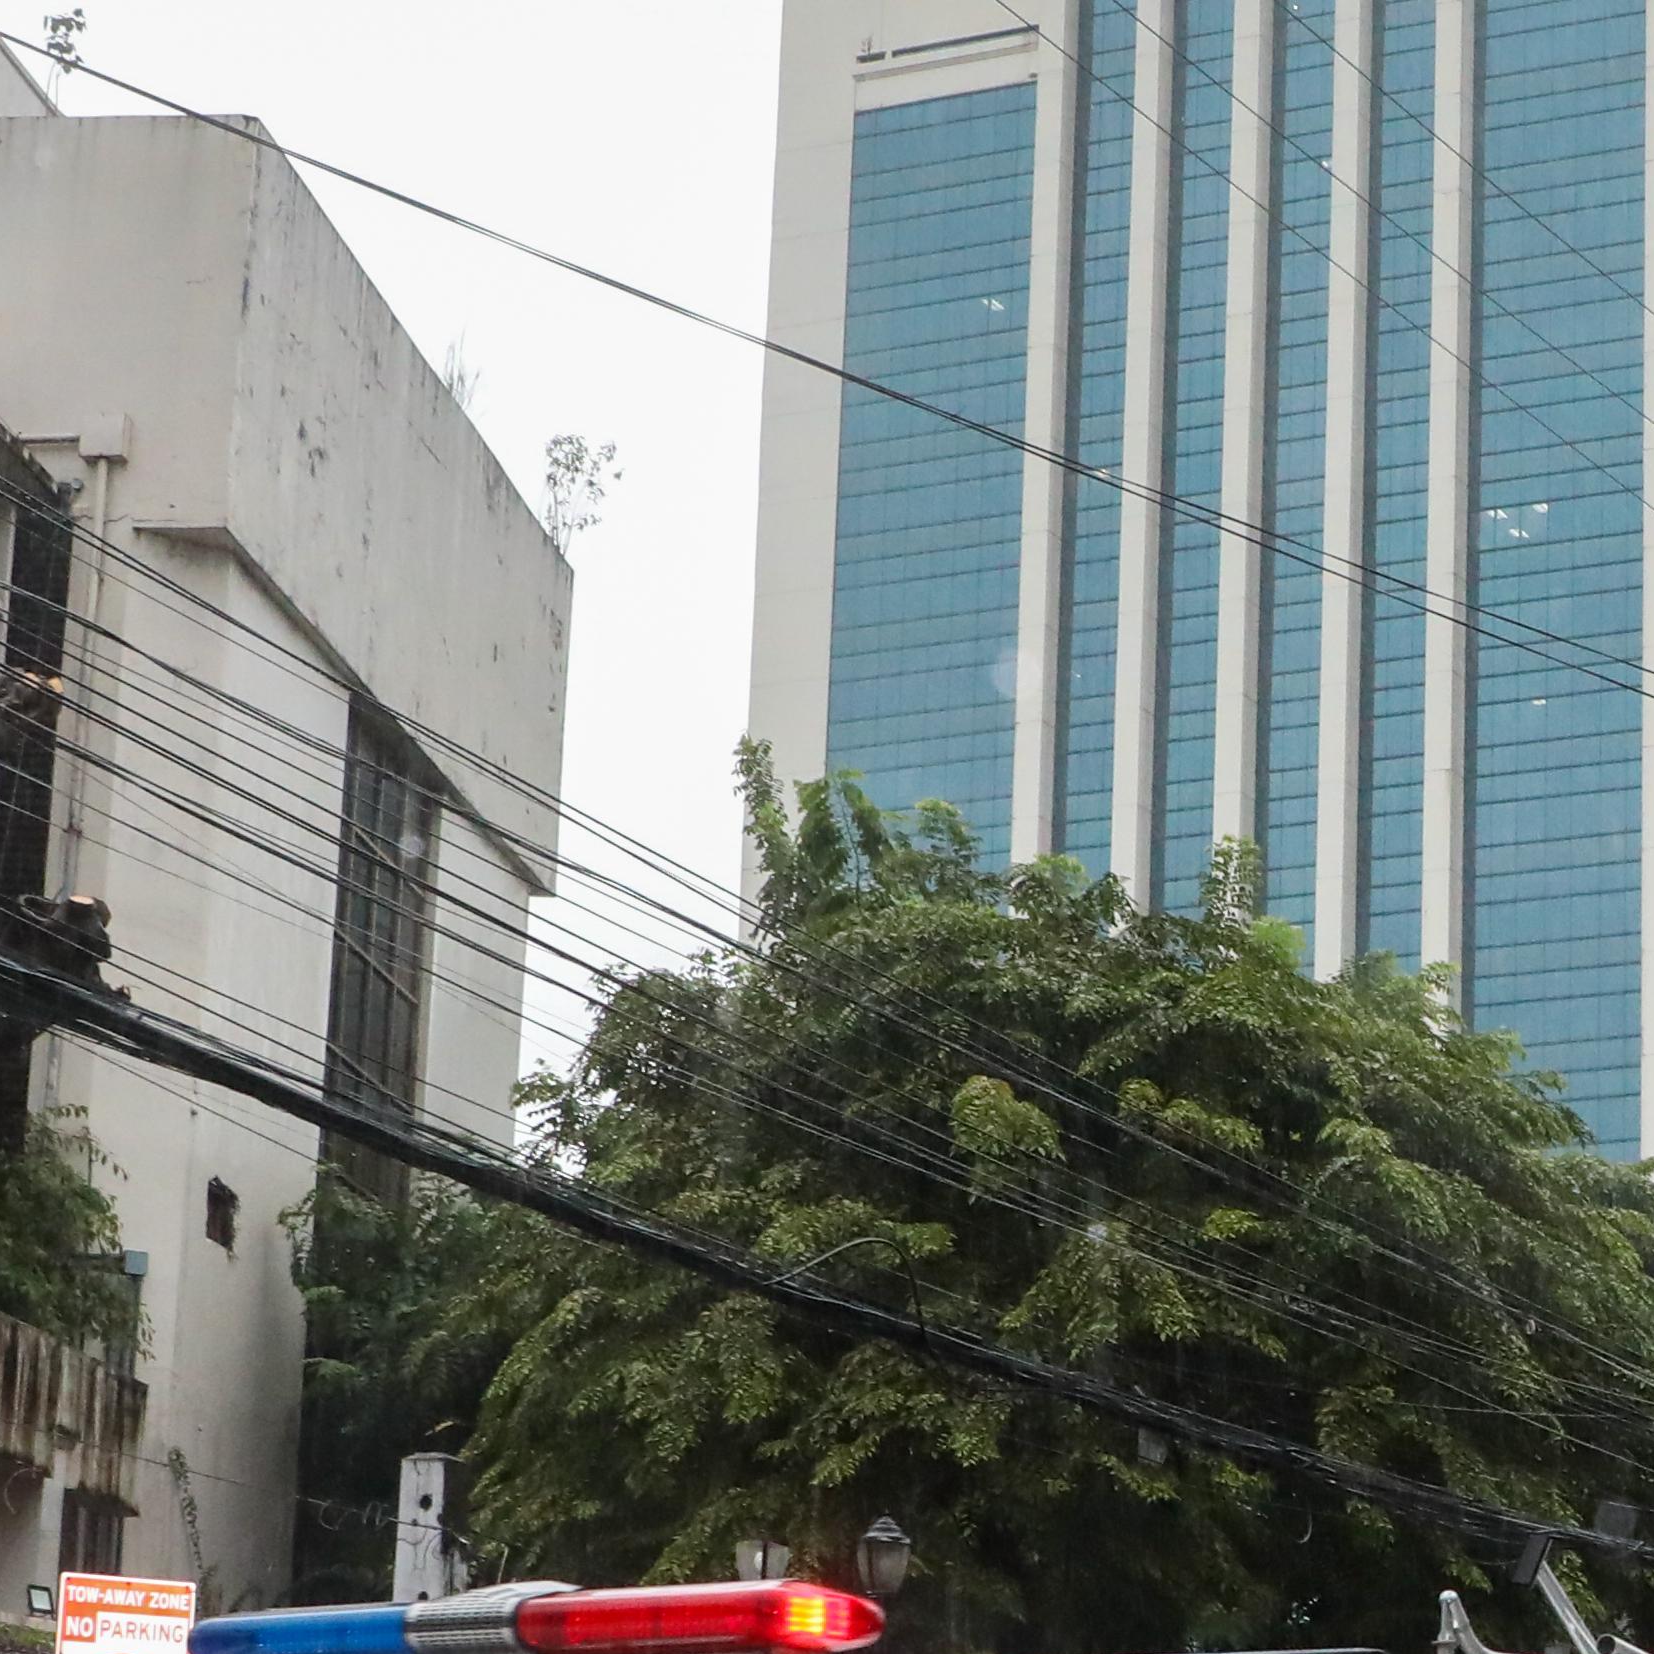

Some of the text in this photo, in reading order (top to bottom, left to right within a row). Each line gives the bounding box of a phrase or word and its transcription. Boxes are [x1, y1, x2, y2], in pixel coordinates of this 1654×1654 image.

[67, 1585, 190, 1610] TOW-AWAY ZONE
[65, 1615, 184, 1643] NO PARKING
